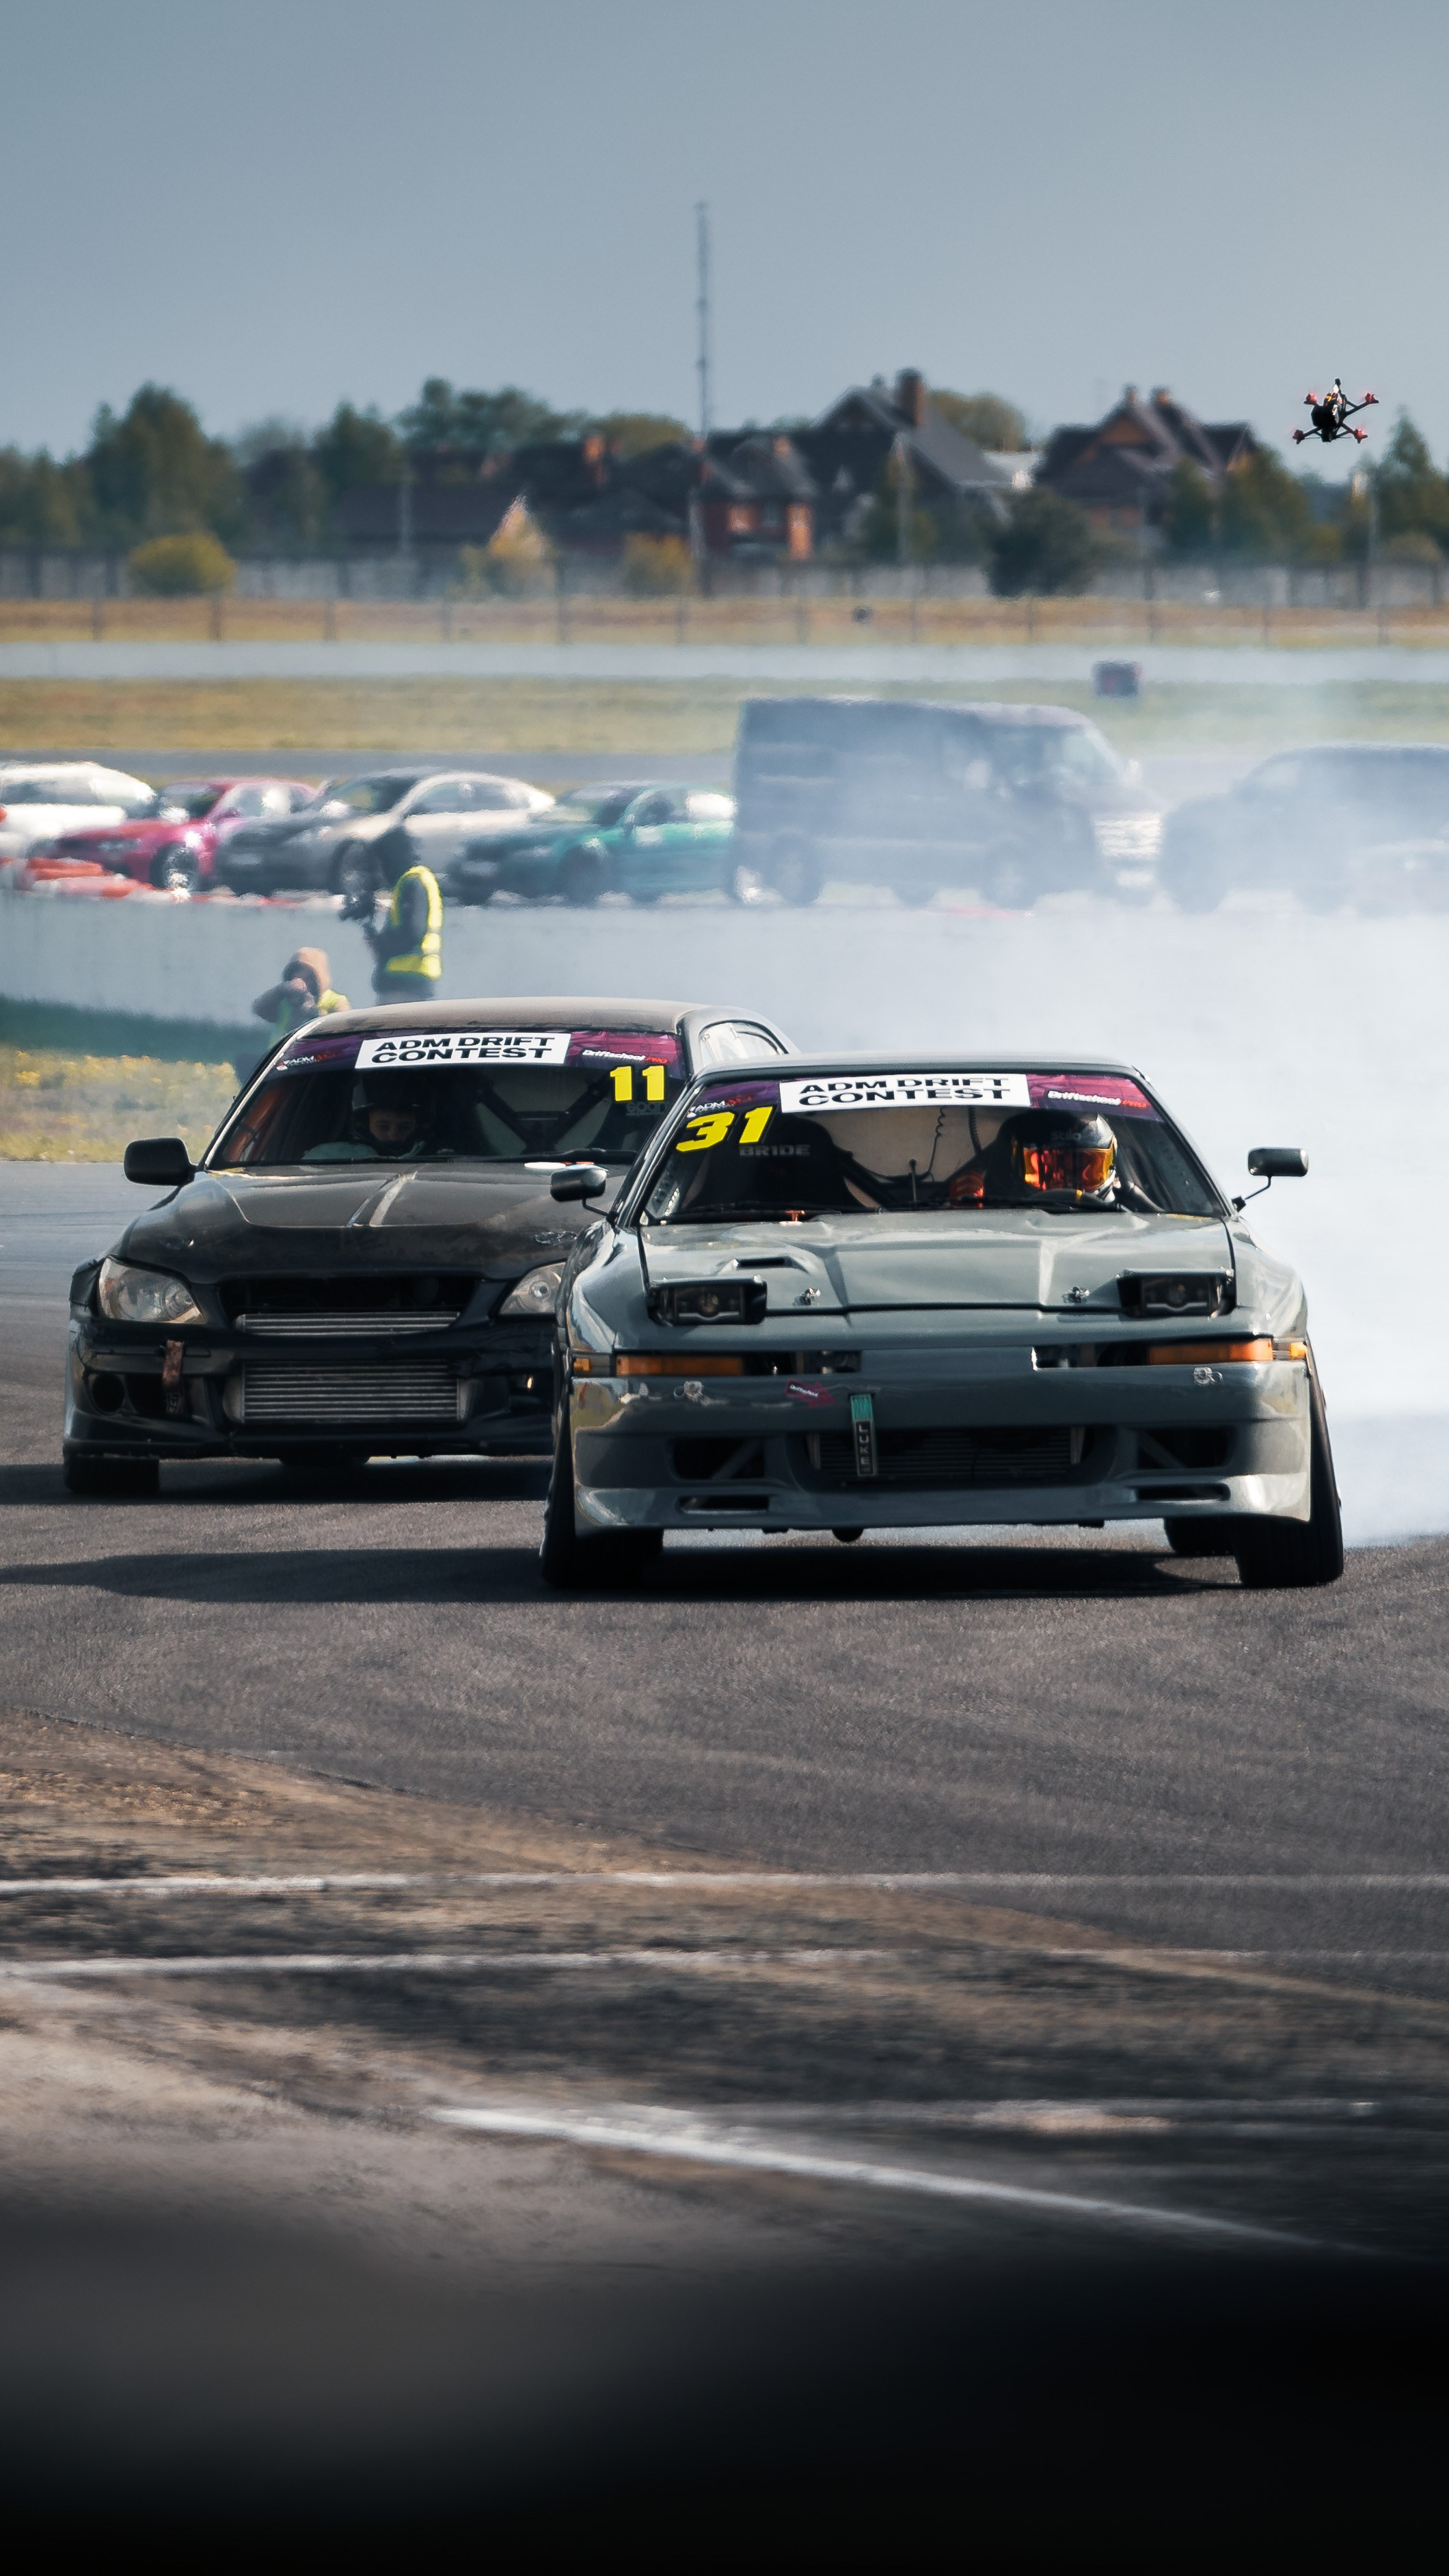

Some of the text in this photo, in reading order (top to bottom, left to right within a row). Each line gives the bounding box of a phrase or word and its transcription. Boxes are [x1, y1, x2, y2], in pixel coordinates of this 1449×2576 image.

[375, 1037, 555, 1052] ADM DRIFT
[371, 1048, 552, 1063] CONTEST
[610, 1065, 664, 1101] 11
[799, 1078, 1009, 1094] ADM DRIFT
[799, 1089, 1010, 1106] CONTEST
[675, 1105, 773, 1152] 31
[739, 1144, 811, 1156] BRIDE
[858, 1424, 870, 1465] LUKE
